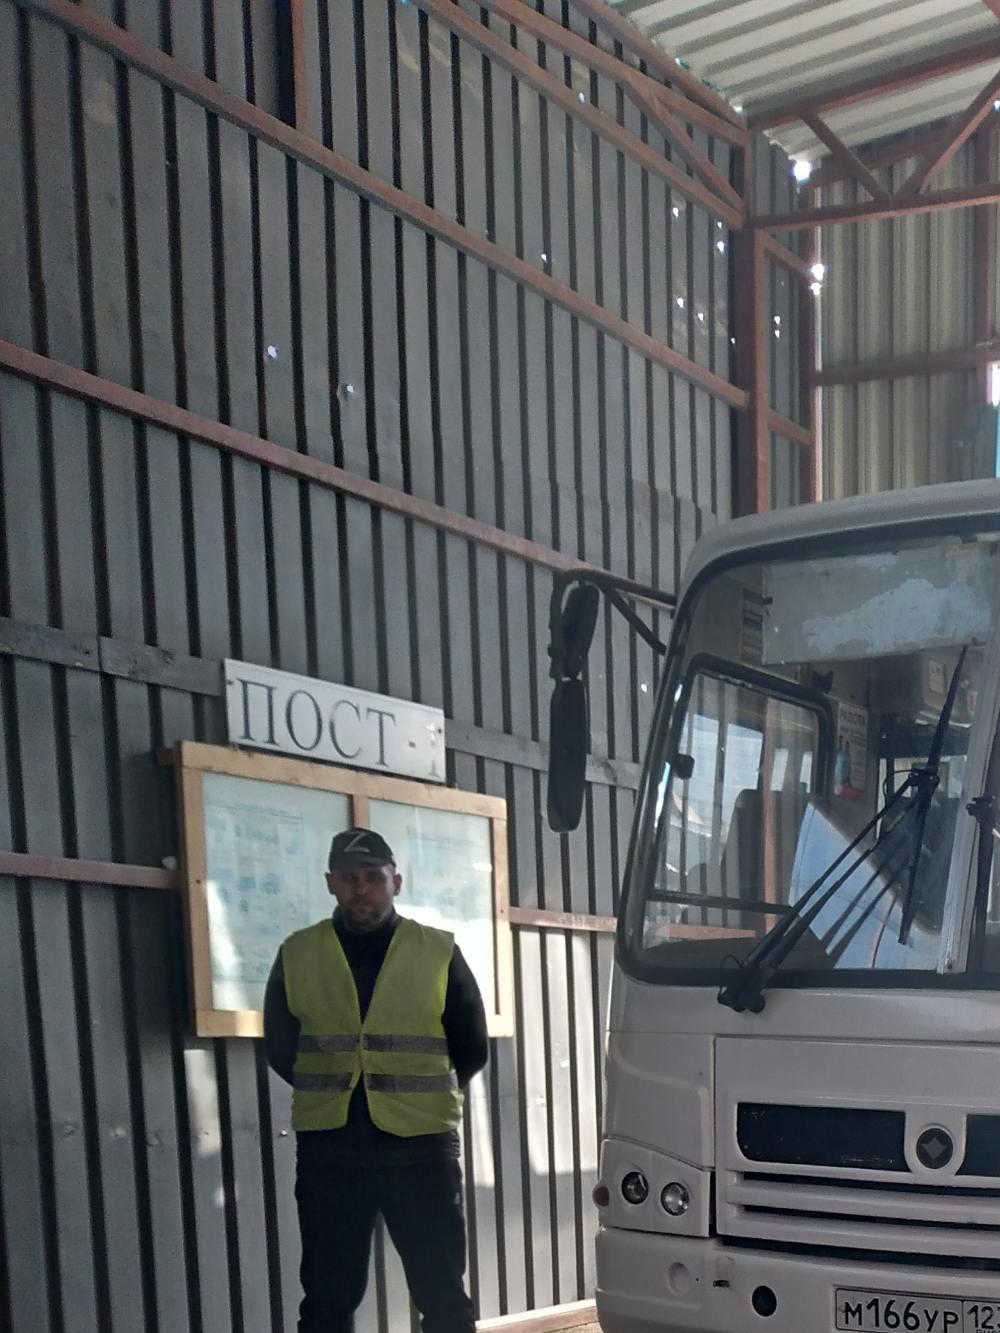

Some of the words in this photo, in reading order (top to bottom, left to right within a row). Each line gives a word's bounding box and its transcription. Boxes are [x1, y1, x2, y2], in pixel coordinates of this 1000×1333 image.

[237, 678, 396, 768] ПОСТ
[344, 831, 370, 853] Z
[843, 1298, 959, 1333] М166УР
